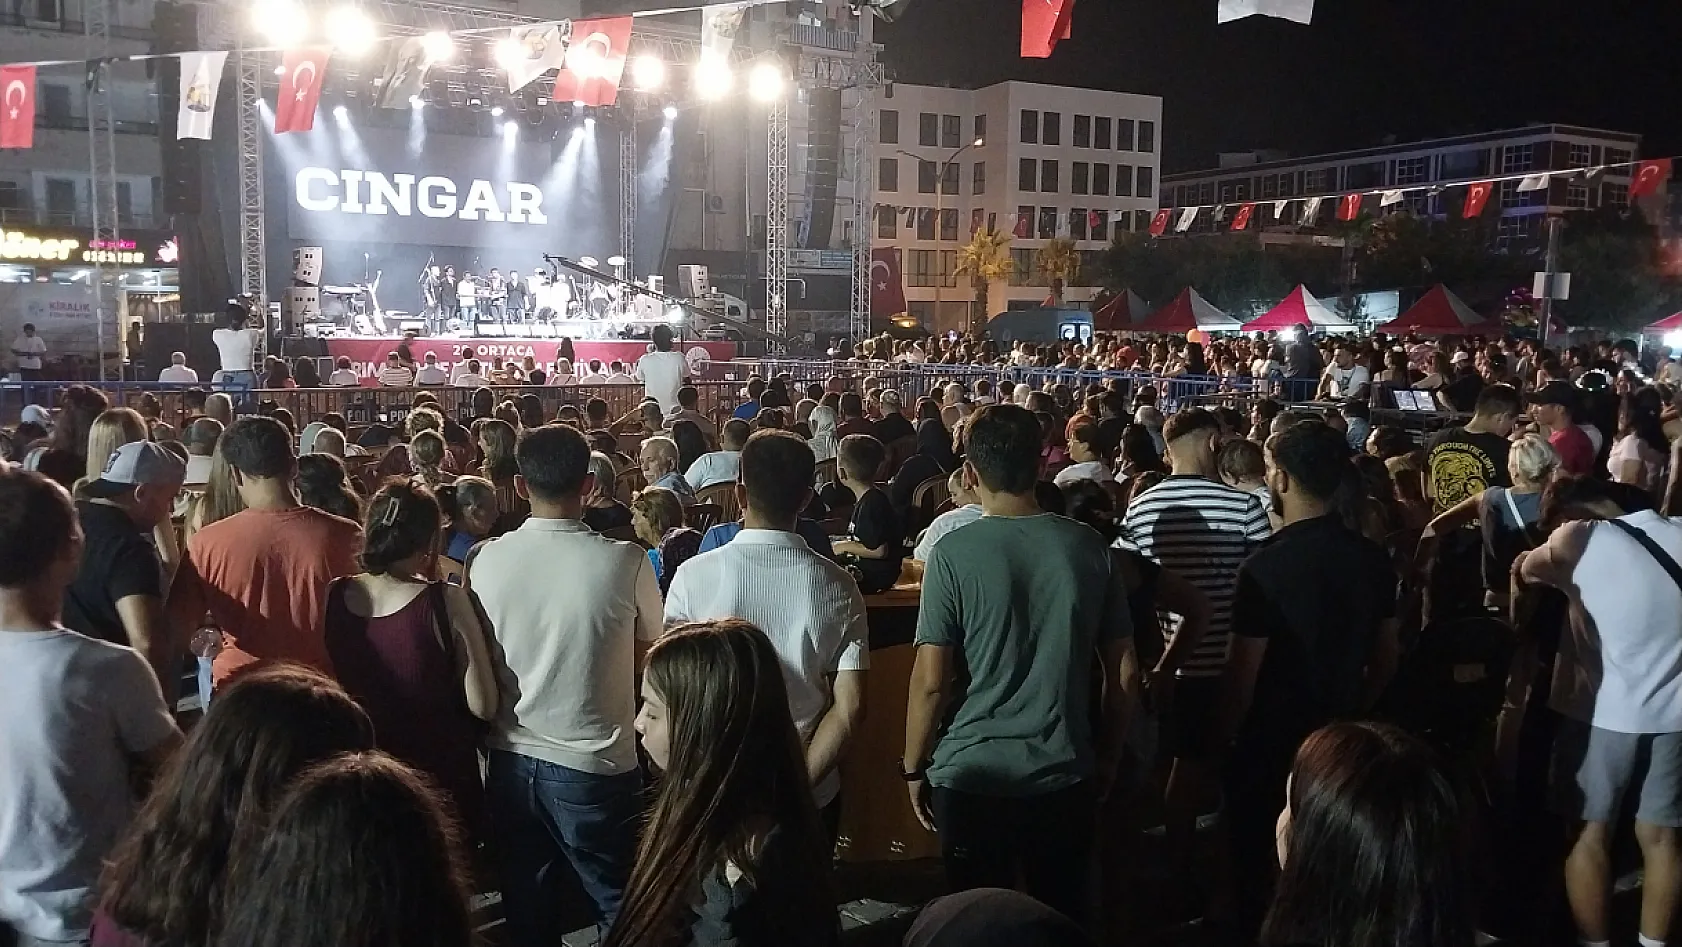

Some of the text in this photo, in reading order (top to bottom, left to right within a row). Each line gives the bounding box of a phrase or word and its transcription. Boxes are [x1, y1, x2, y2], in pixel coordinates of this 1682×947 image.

[295, 166, 548, 225] CINGAR
[0, 228, 80, 260] öner
[477, 345, 535, 357] ORTACA
